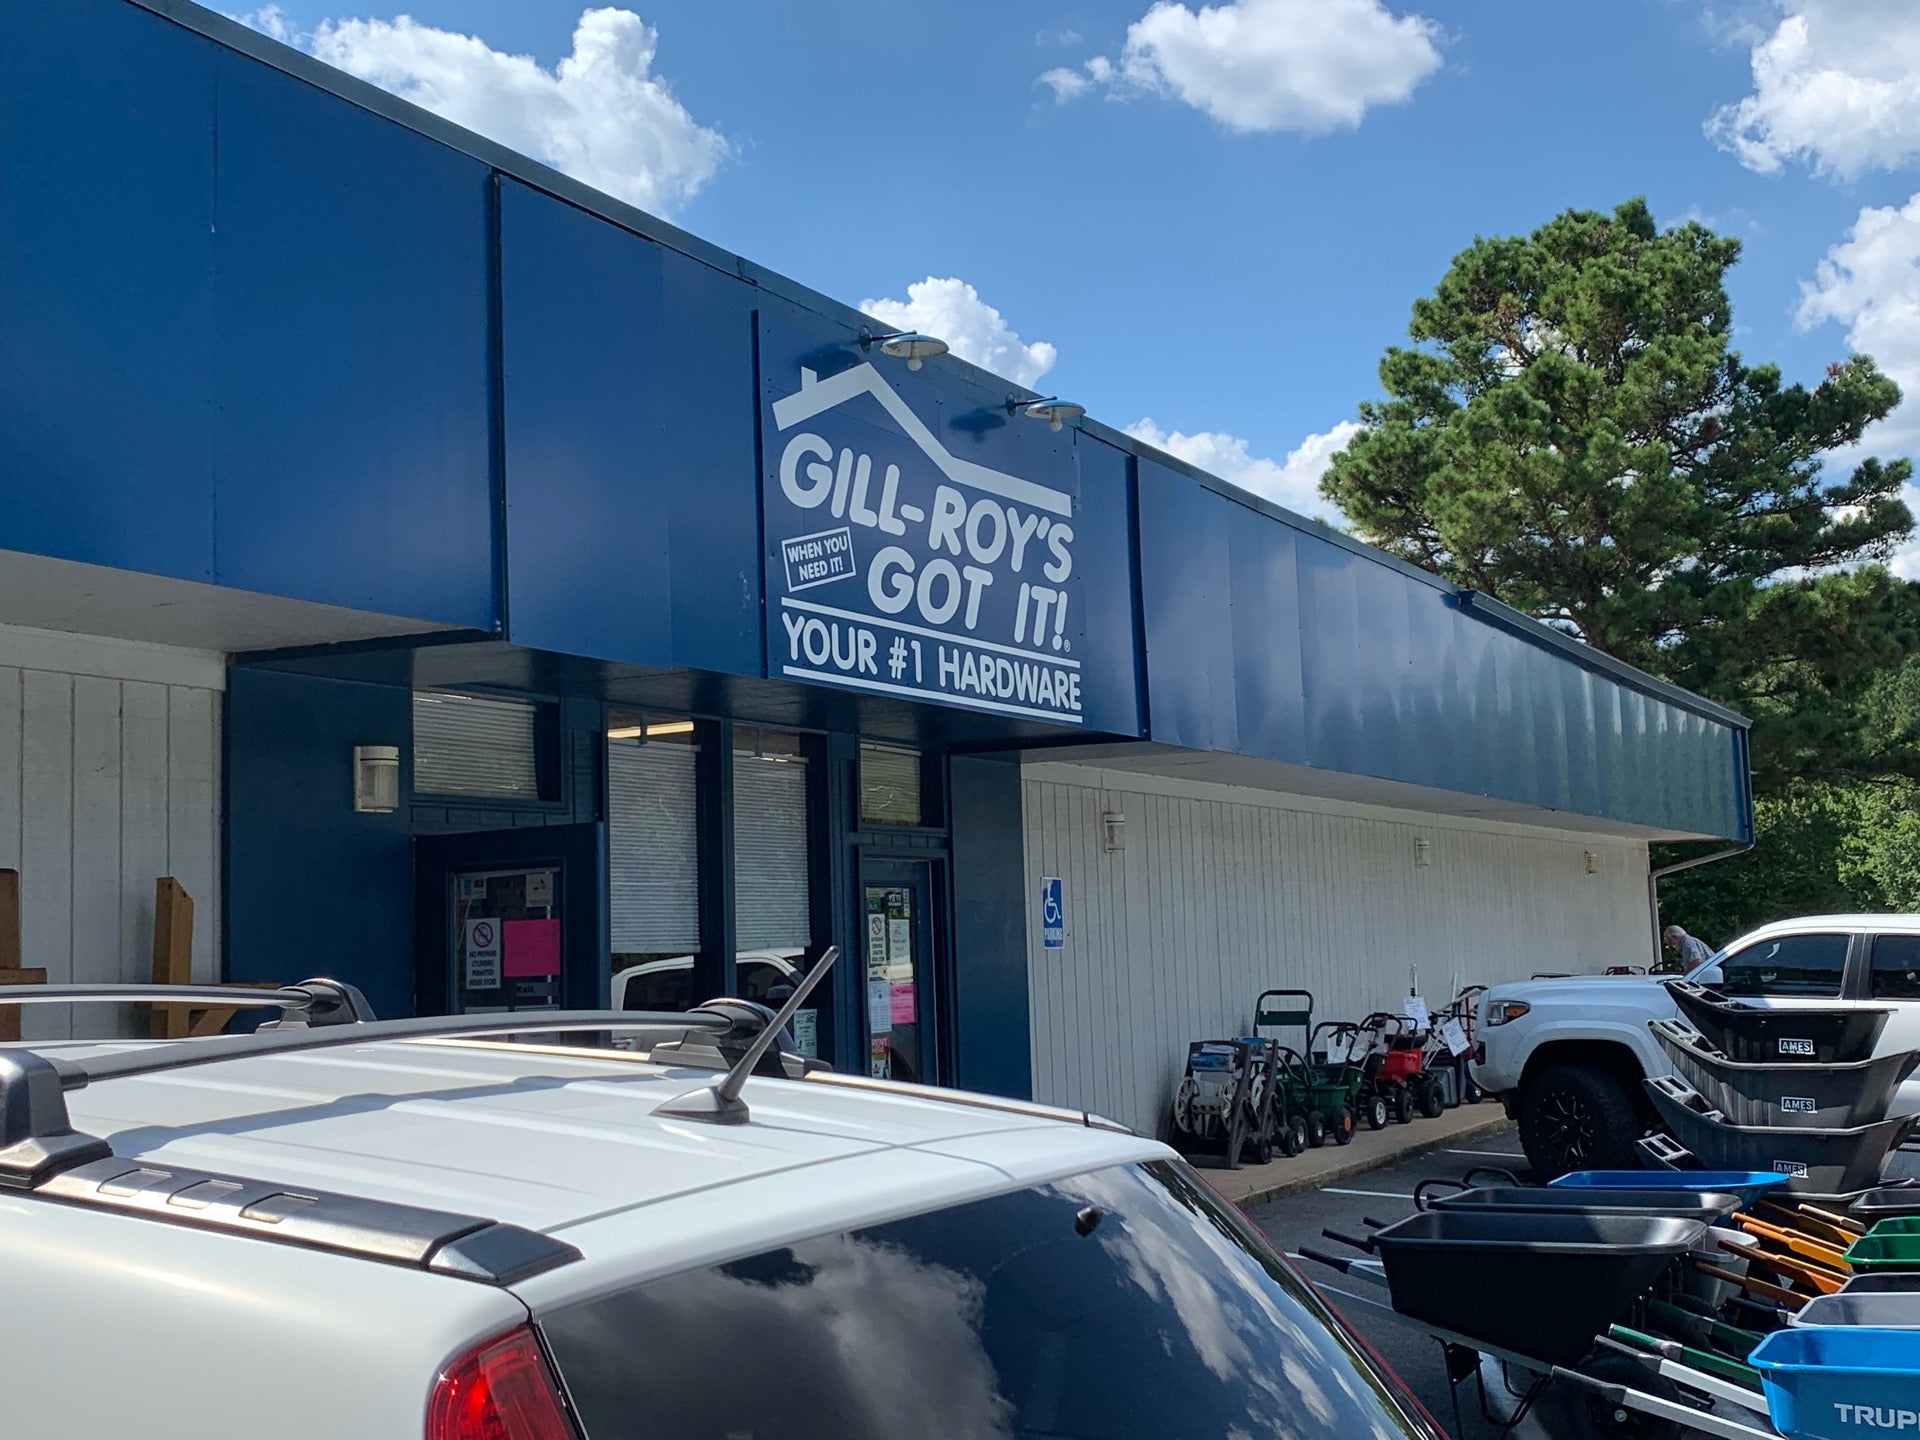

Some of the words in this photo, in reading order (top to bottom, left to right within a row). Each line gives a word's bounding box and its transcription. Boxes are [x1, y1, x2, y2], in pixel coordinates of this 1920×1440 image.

[780, 433, 1074, 583] GILL-ROY'S
[787, 541, 822, 563] WHEN
[824, 535, 848, 554] YOU
[799, 560, 828, 581] NEED
[830, 556, 844, 573] IT!
[868, 546, 993, 630] GOT
[1014, 582, 1068, 651] IT!
[782, 612, 878, 675] YOUR
[888, 637, 922, 683] #1
[939, 645, 1082, 711] HARDWARE
[1782, 1041, 1810, 1052] AMES
[1784, 1099, 1813, 1110] AMES
[1777, 1163, 1804, 1175] AMES
[1834, 1403, 1920, 1432] TRUP
